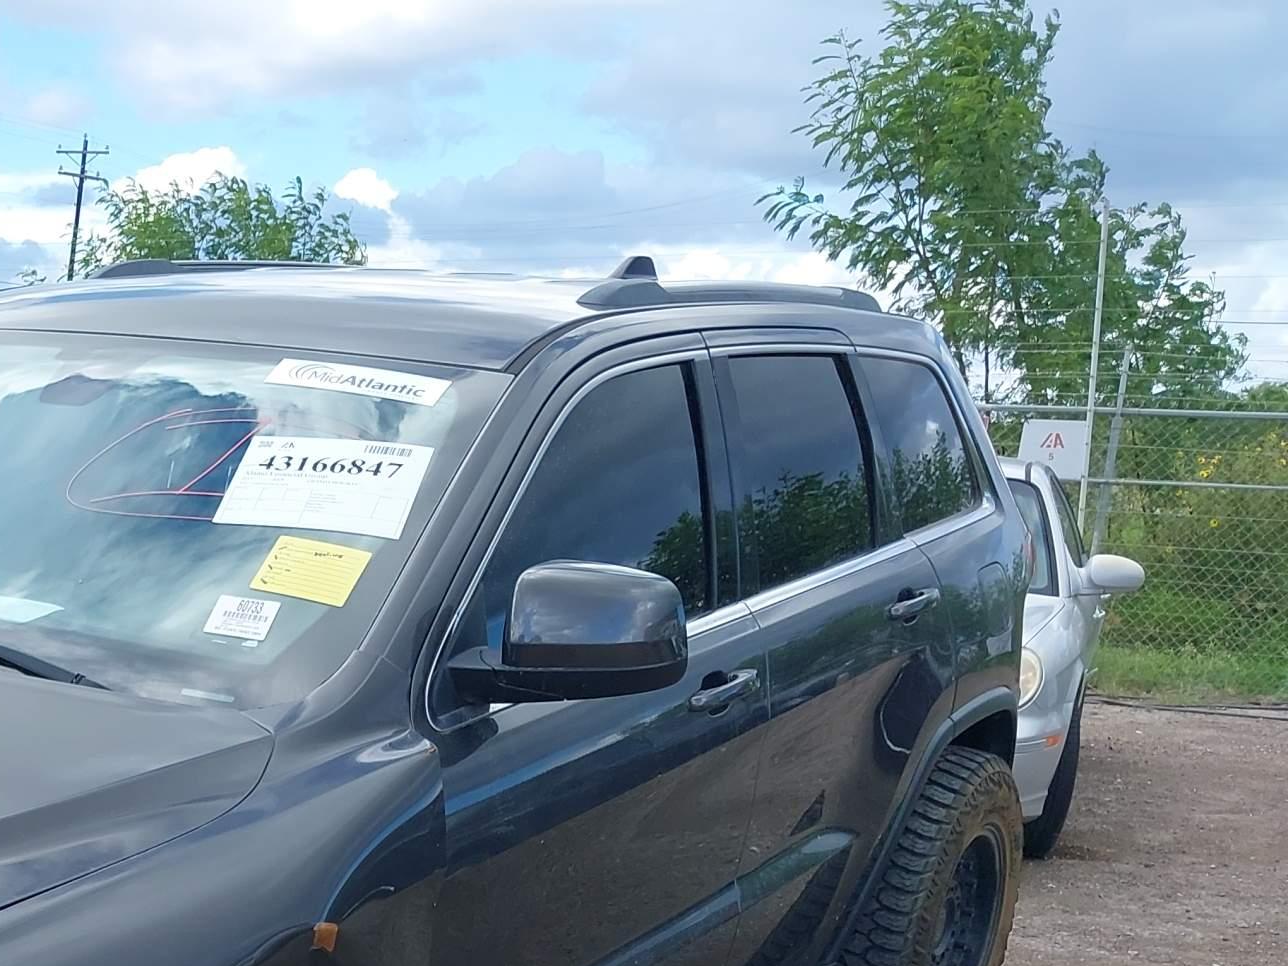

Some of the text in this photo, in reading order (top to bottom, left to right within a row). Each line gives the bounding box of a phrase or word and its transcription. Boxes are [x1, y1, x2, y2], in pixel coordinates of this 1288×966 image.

[307, 369, 427, 398] MidAtlantic
[258, 455, 405, 479] 43166847
[236, 599, 265, 615] 60733
